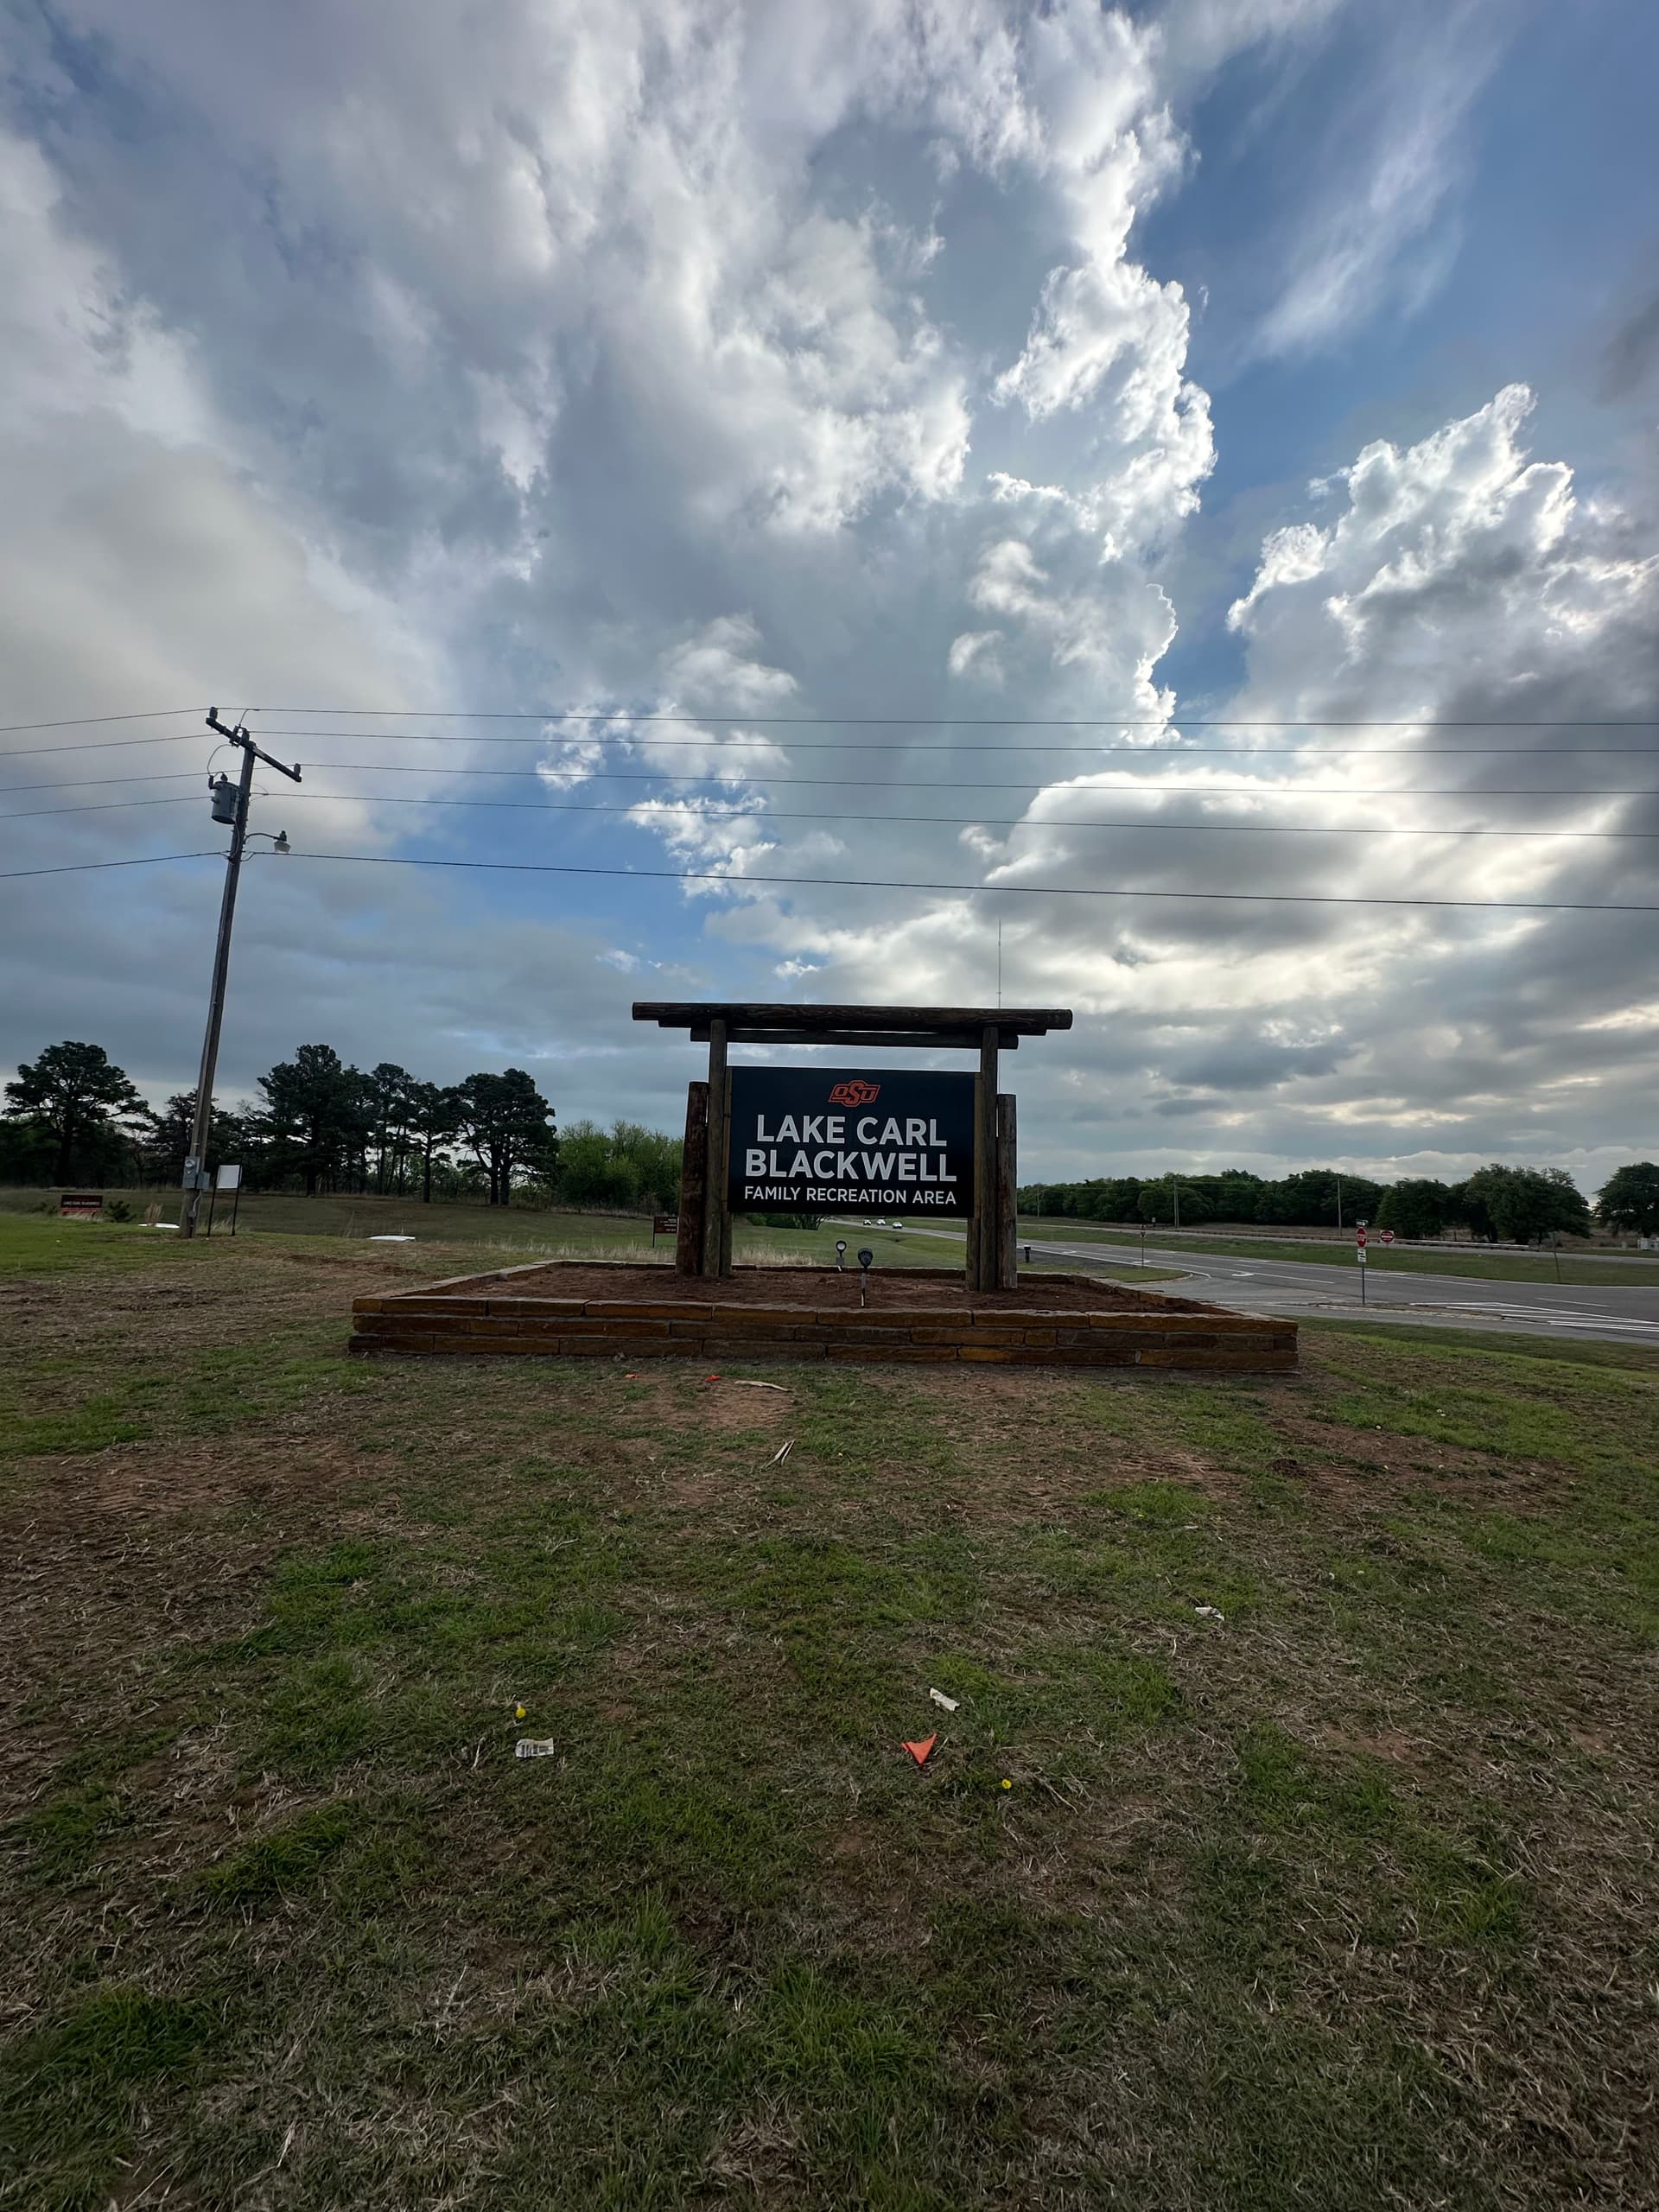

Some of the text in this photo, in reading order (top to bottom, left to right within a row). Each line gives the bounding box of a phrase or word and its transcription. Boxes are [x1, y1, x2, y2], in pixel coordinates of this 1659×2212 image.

[828, 1080, 880, 1107] OSU
[757, 1115, 947, 1147] LAKE CARL
[745, 1148, 957, 1182] BLACKWELL
[744, 1185, 957, 1205] FAMILY RECREATION AREA
